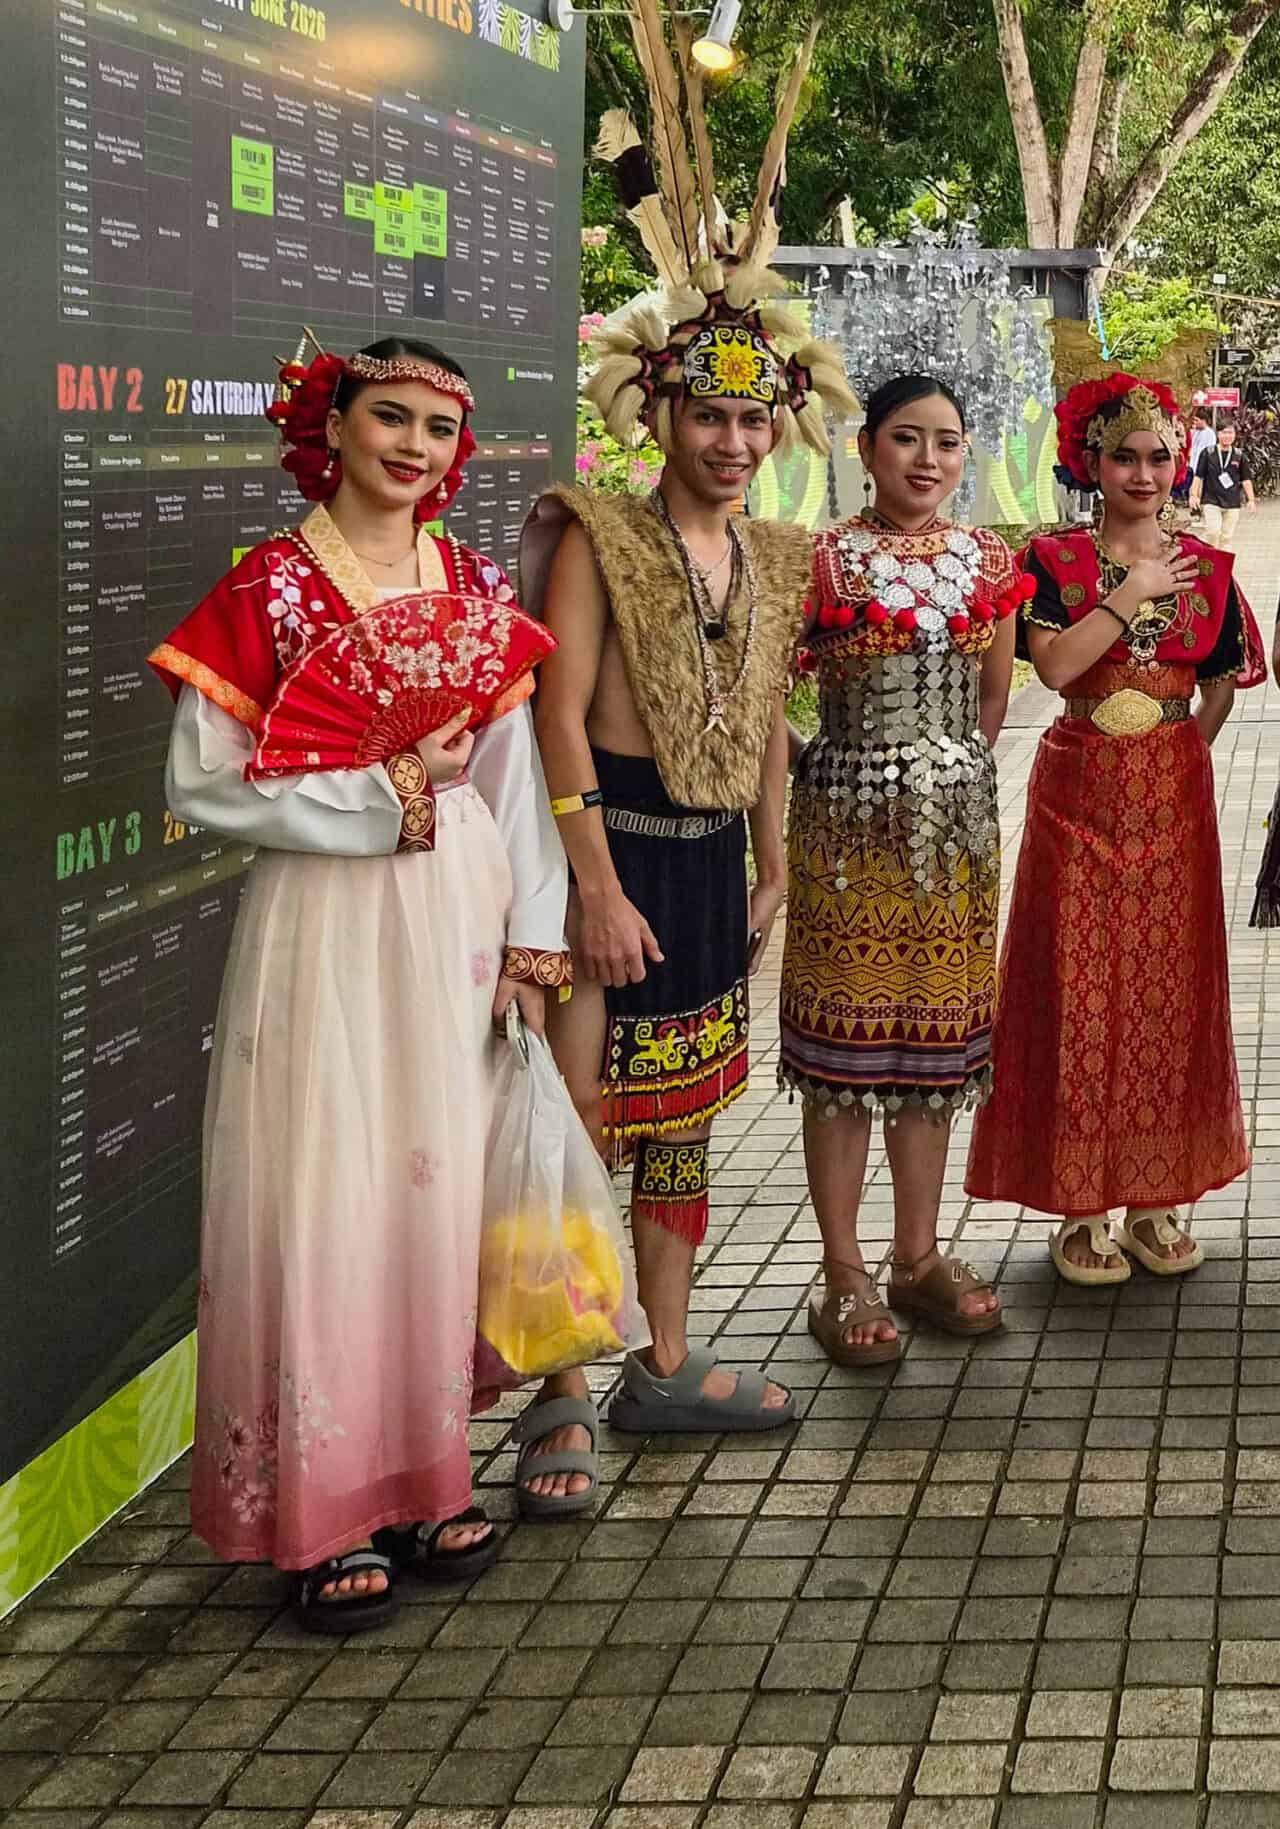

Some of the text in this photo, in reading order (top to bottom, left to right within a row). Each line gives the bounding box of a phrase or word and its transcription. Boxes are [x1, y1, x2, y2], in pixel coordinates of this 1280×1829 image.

[290, 0, 326, 41] 2026
[56, 363, 275, 416] DAY 2 27 SATURDAY
[56, 817, 117, 881] DAY
[124, 810, 142, 856] 3
